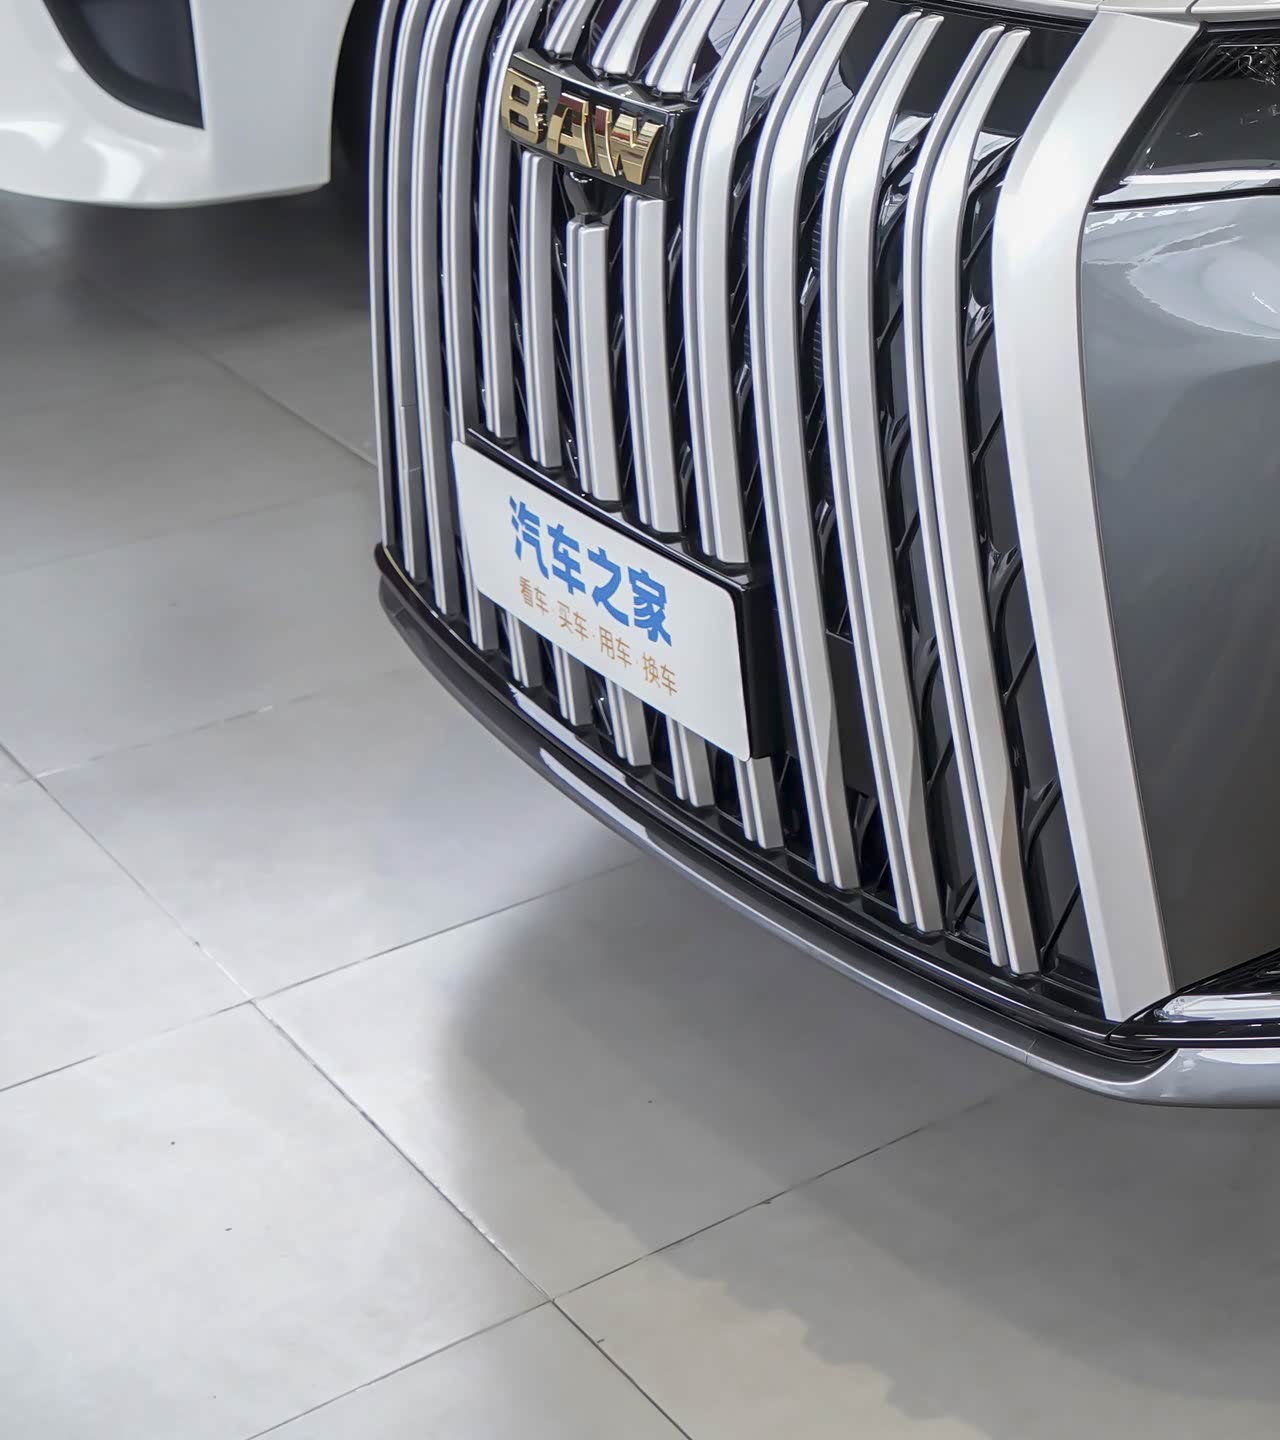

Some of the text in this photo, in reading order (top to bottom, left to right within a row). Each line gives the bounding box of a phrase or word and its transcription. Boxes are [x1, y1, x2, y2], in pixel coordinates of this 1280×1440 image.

[501, 67, 664, 186] BAW
[509, 495, 672, 647] 汽车之家
